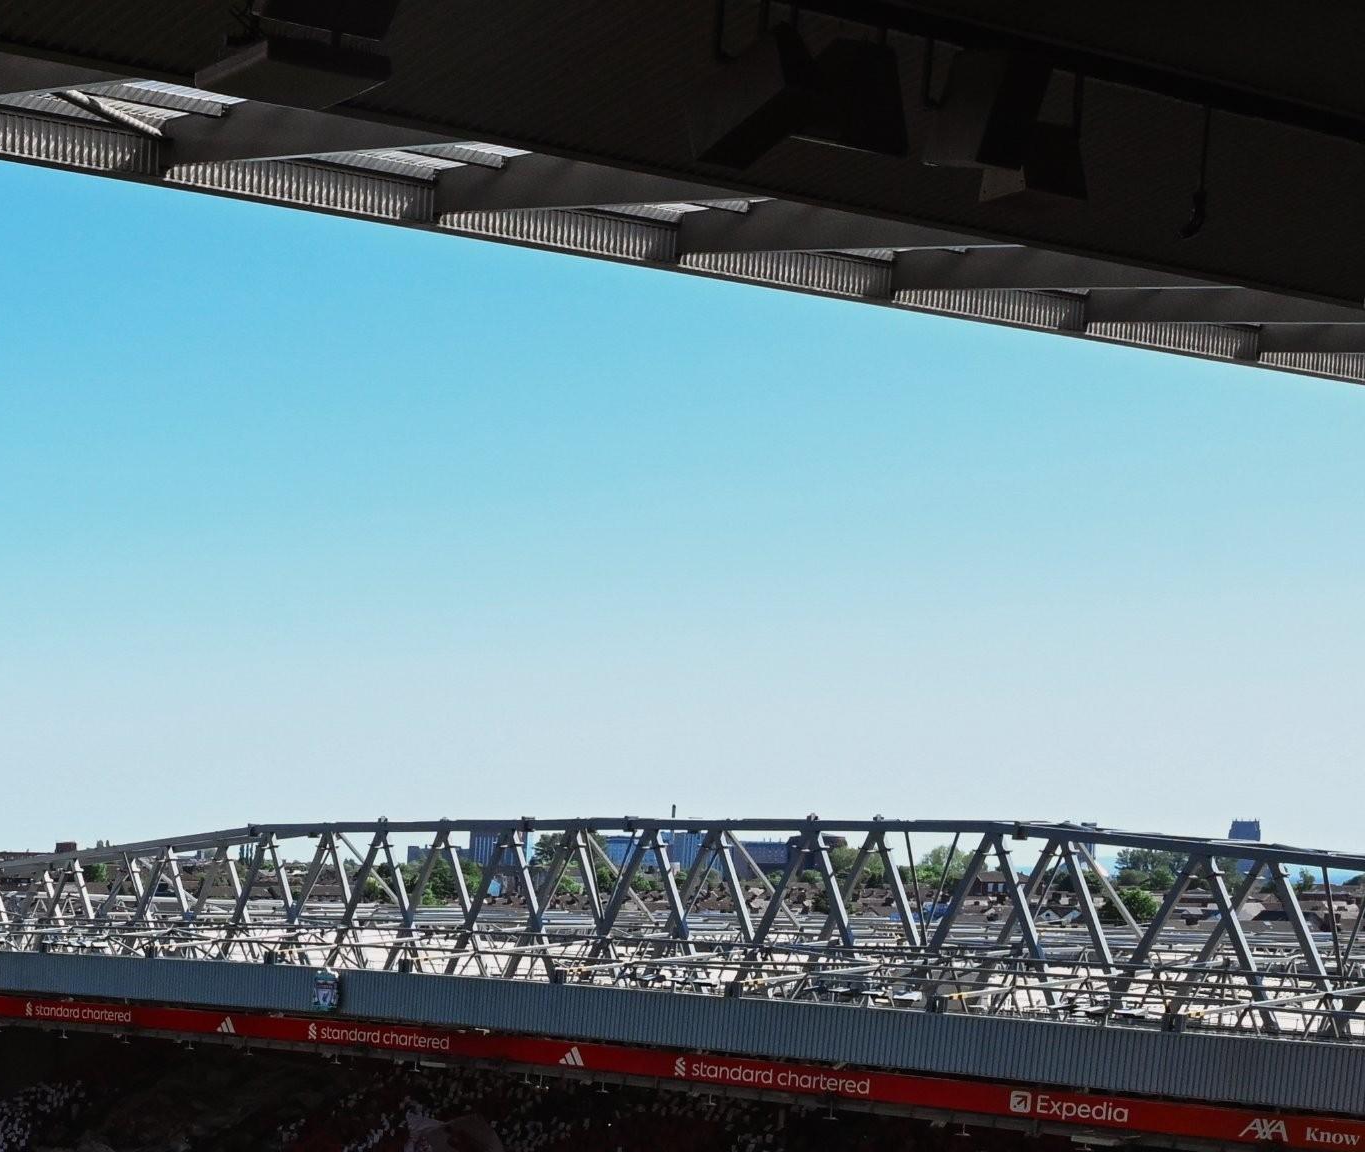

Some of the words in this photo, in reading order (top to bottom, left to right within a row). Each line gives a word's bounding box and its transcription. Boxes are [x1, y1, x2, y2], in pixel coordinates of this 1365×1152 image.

[35, 1004, 80, 1019] standard
[81, 1008, 131, 1023] chartered
[320, 1025, 381, 1044] standard
[383, 1031, 450, 1050] chartered
[692, 1062, 773, 1084] standard
[777, 1069, 870, 1094] chartered
[1036, 1095, 1129, 1123] Expedia
[1238, 1118, 1289, 1142] AXA
[1305, 1126, 1361, 1146] Know
